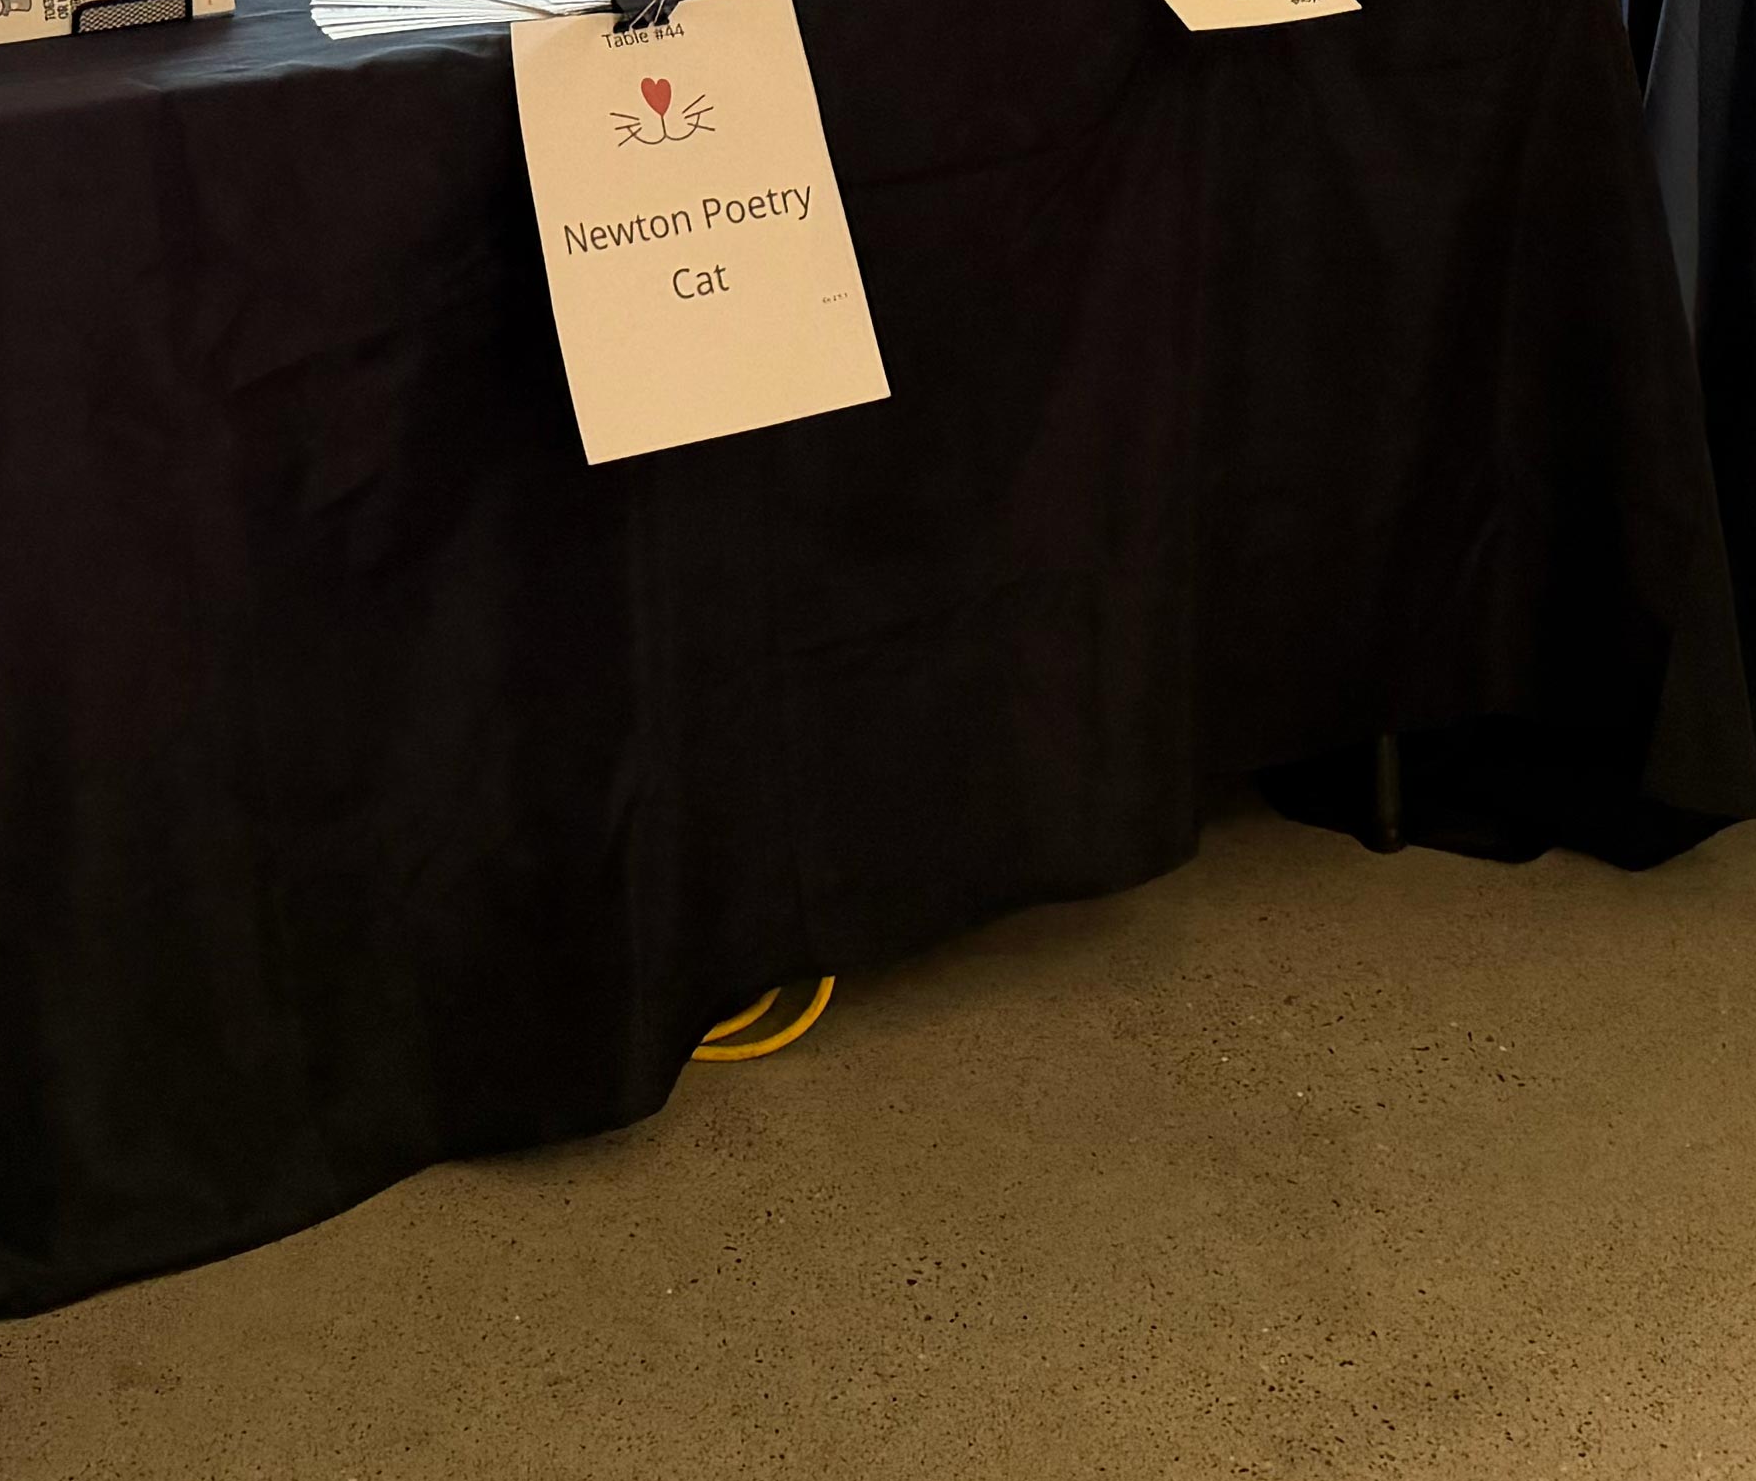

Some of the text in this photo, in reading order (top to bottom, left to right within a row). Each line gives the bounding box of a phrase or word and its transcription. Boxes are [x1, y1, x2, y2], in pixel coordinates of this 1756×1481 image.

[602, 23, 685, 49] Table #44
[564, 186, 811, 254] Newton Poetry
[672, 264, 730, 299] Cat
